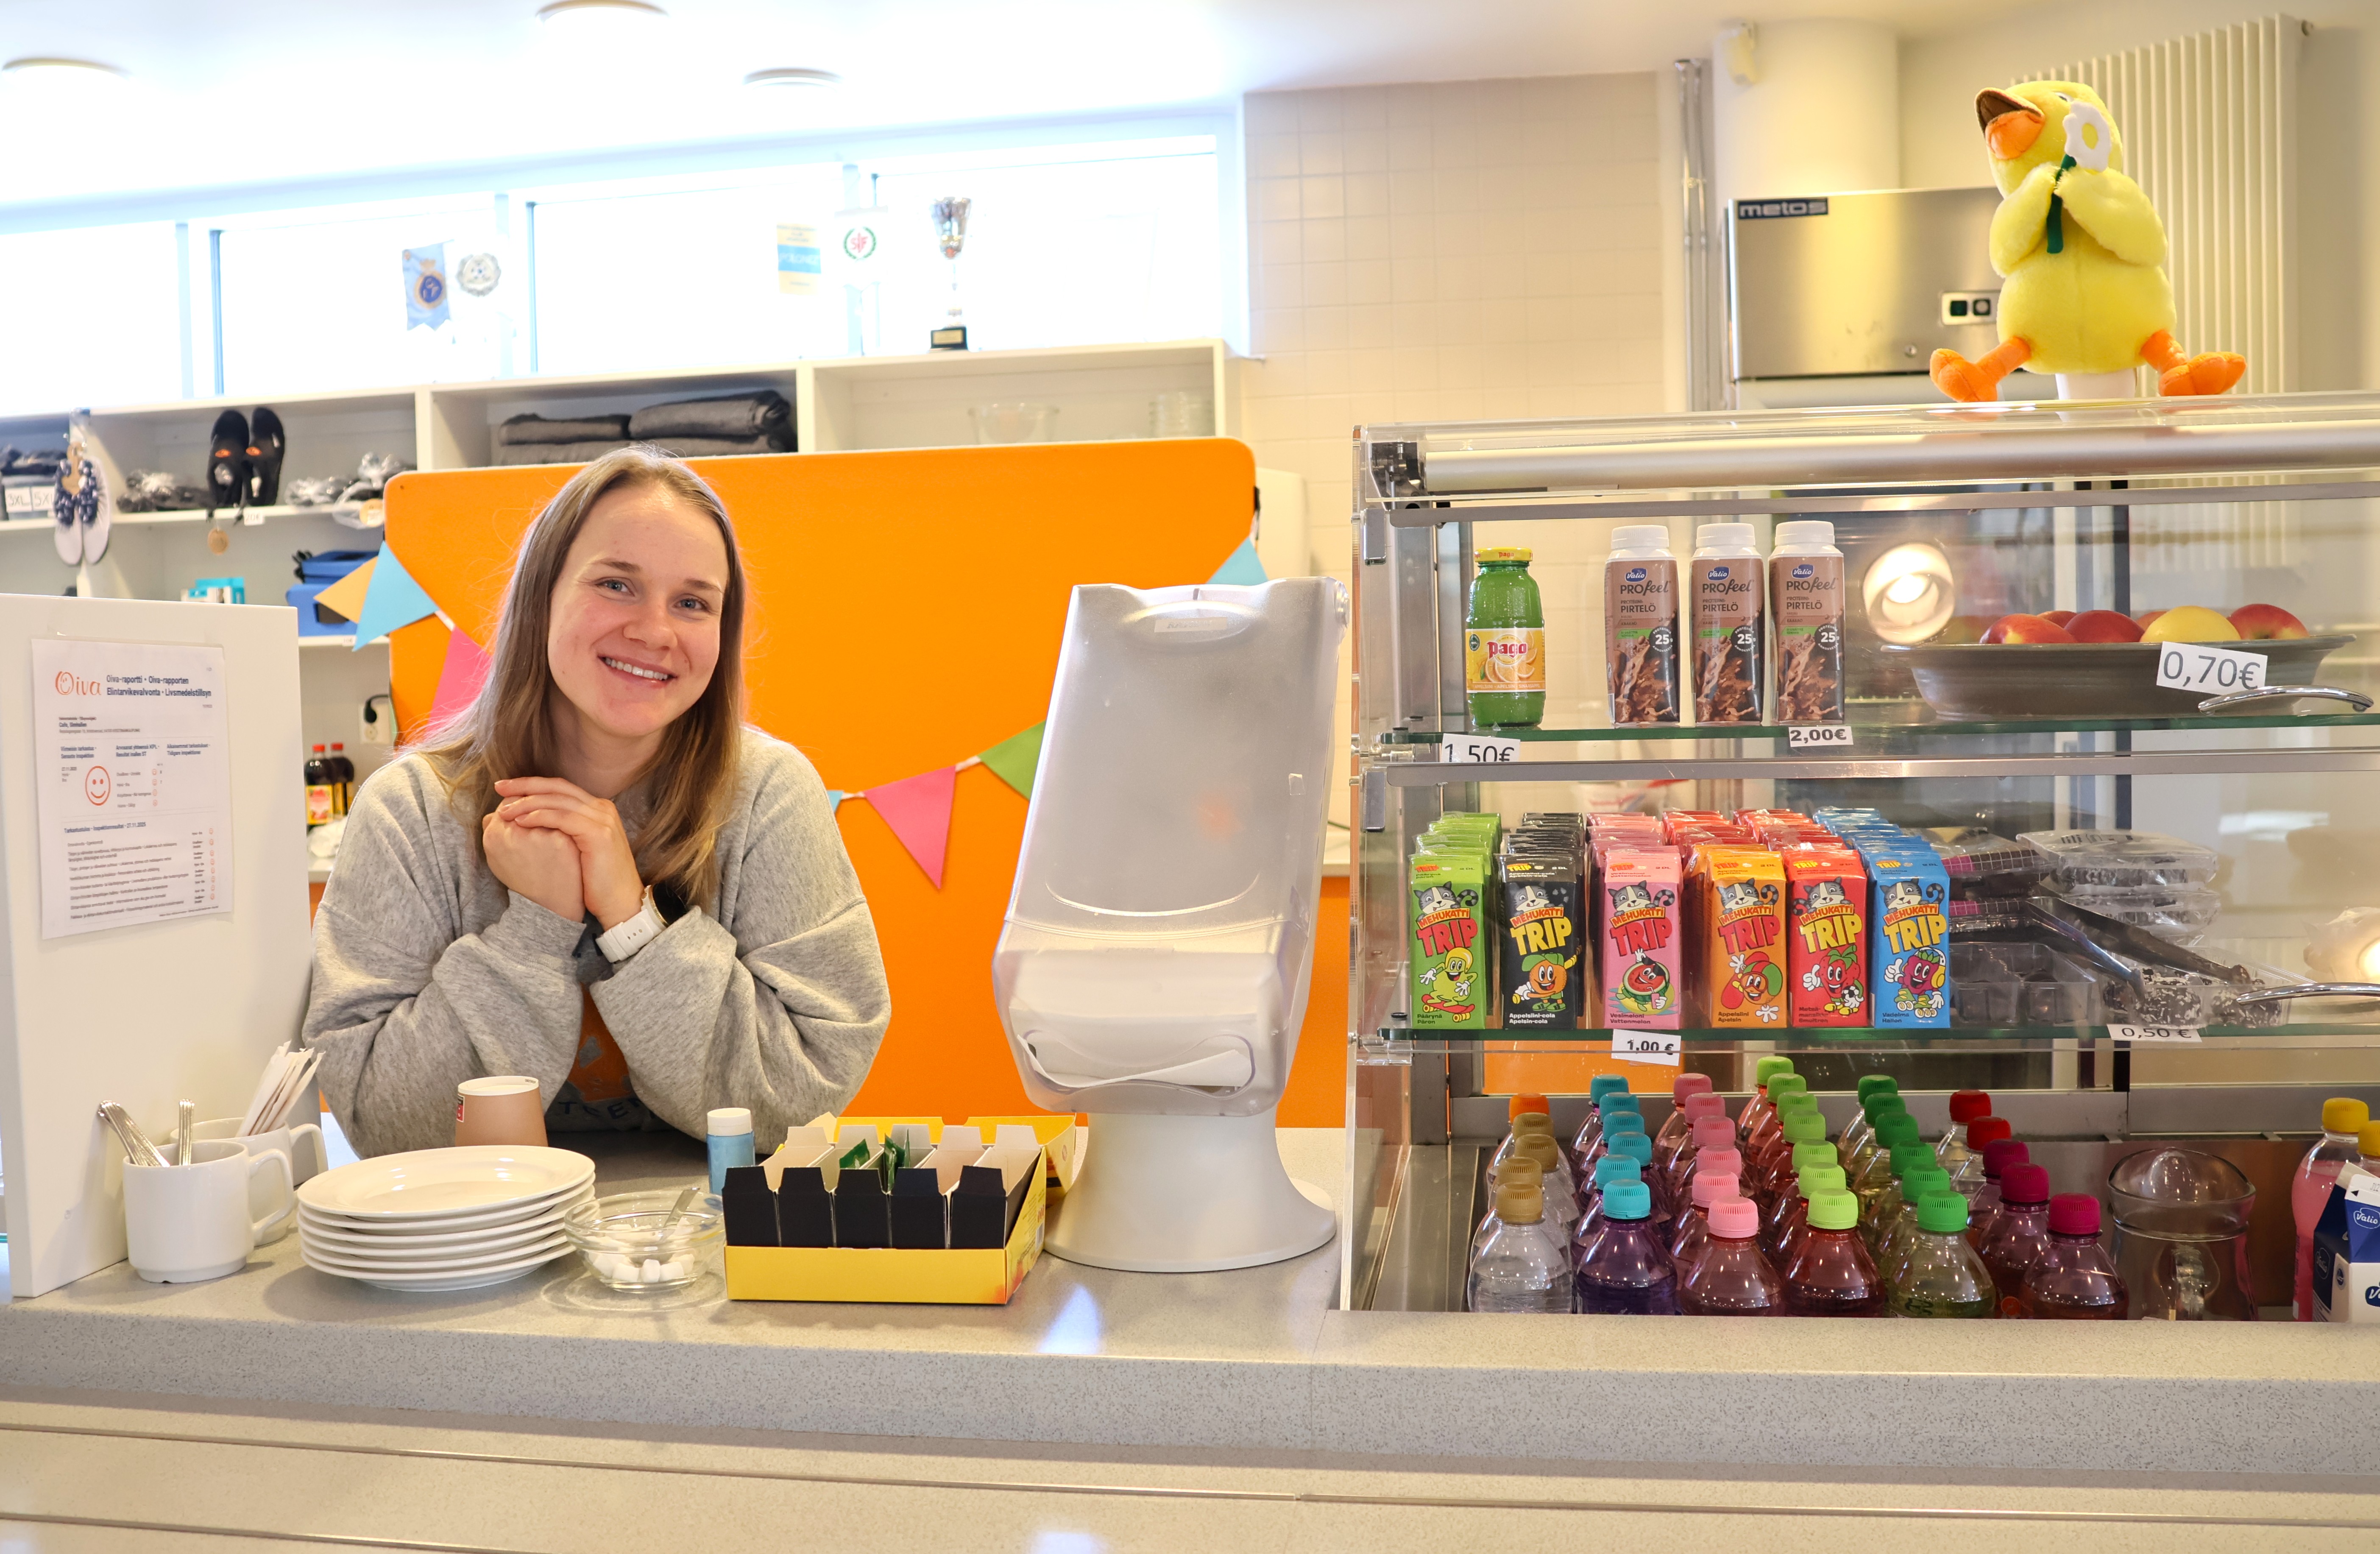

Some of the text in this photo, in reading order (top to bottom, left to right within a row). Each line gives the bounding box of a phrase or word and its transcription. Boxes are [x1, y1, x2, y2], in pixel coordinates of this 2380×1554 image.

[1739, 201, 1827, 217] metos
[1620, 580, 1669, 596] PROfeel
[1702, 579, 1753, 595] PROfeel
[1786, 577, 1837, 593] PROfeel
[1621, 603, 1655, 613] PIRTELÖ
[1703, 602, 1738, 611] PIRTELÖ
[1786, 600, 1822, 609] PIRTELÖ
[1655, 634, 1669, 645] 25
[1737, 633, 1752, 644] 25
[1821, 632, 1836, 642] 25
[1486, 641, 1527, 660] pago
[2163, 651, 2260, 690] 0,70€
[55, 671, 102, 695] Oiva
[106, 675, 189, 685] Oiva-raportti Oiva-rapporten
[107, 687, 212, 697] Elintarvikevalvonta Livsmedelstillsyn
[1790, 728, 1847, 742] 2,00€
[1416, 917, 1478, 957] TRIP
[1510, 916, 1572, 956] TRIP
[1609, 918, 1673, 957] TRIP
[1718, 915, 1780, 954] TRIP
[1799, 913, 1862, 954] TRIP
[1883, 913, 1947, 954] TRIP
[2121, 1028, 2191, 1038] 0,50 €
[1627, 1040, 1674, 1055] 1,00 €
[2356, 1214, 2378, 1224] Valio
